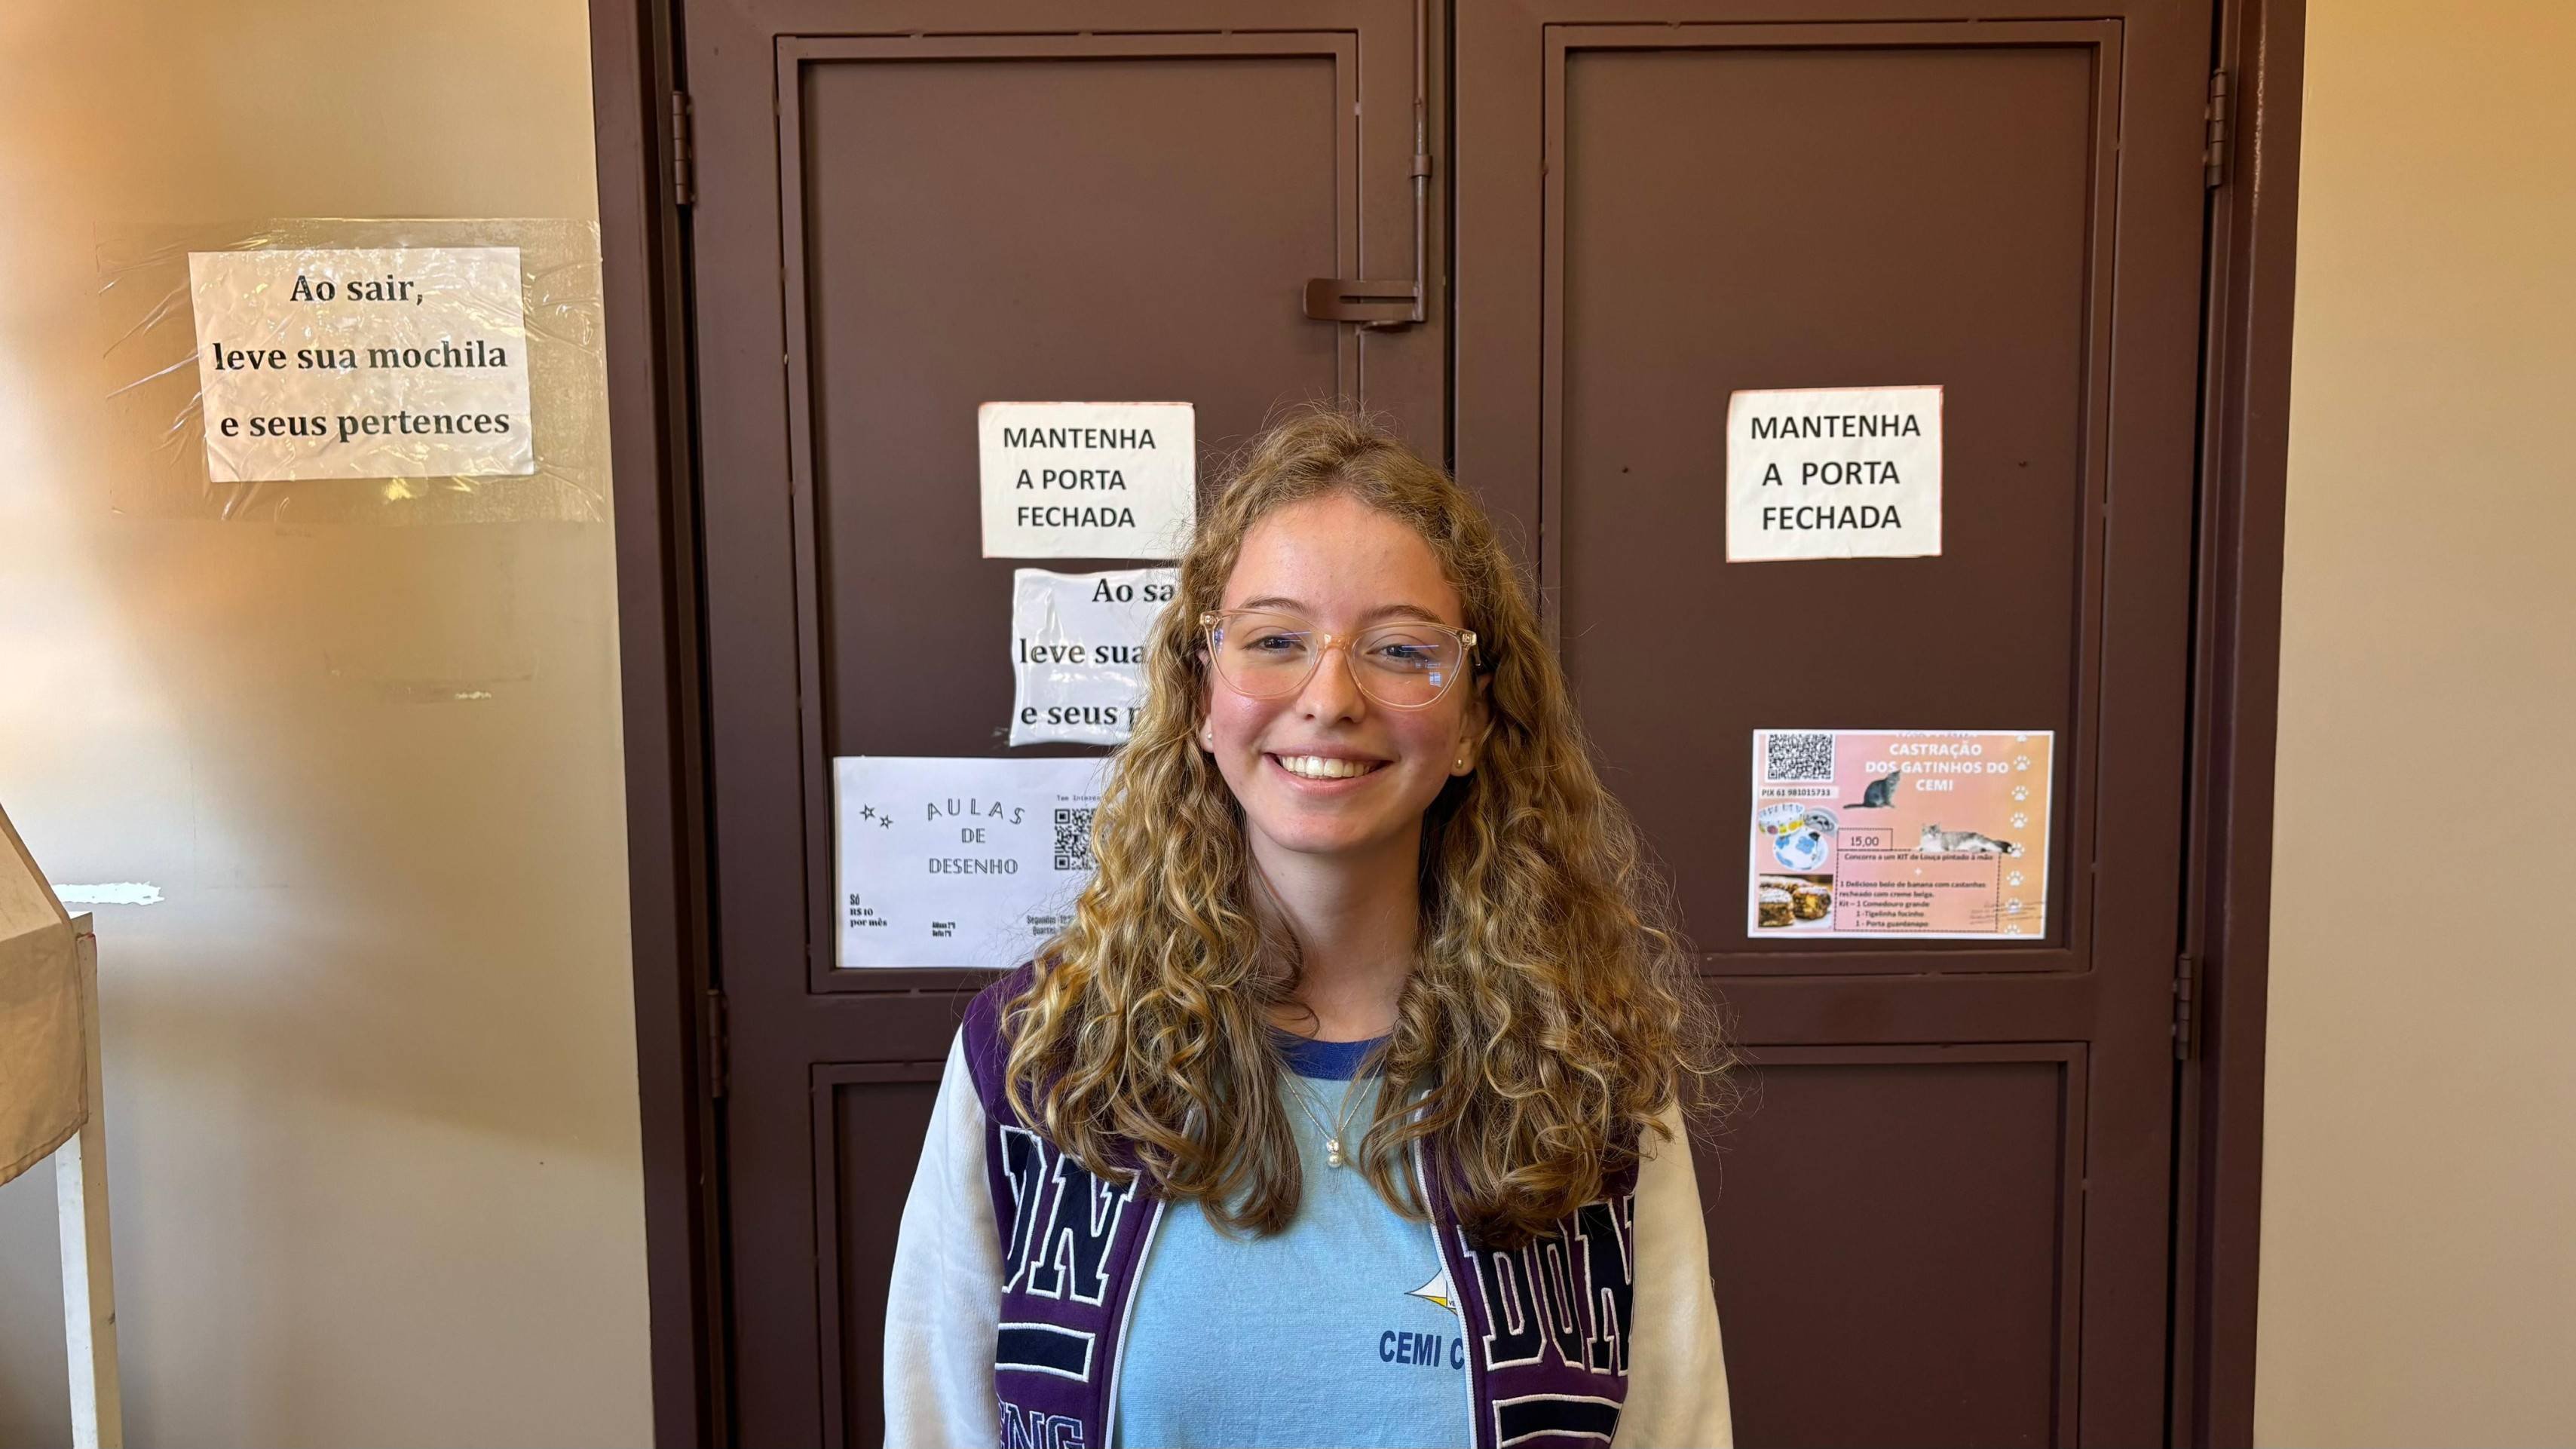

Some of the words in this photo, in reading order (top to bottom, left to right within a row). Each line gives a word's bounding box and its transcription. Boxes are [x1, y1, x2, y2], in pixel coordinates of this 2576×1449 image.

[290, 274, 335, 302] Ao
[347, 274, 424, 306] sair,
[214, 342, 286, 370] leve
[297, 347, 357, 369] sua
[369, 340, 507, 369] mochila
[220, 416, 239, 437] e
[250, 414, 327, 436] seus
[338, 409, 510, 443] pertences
[1751, 414, 1921, 440] MANTENHA
[1003, 427, 1156, 449] MANTENHA
[1016, 469, 1034, 489] A
[1043, 469, 1126, 490] PORTA
[1762, 463, 1783, 486] A
[1803, 461, 1900, 485] PORTA
[1018, 507, 1135, 528] FECHADA
[1763, 505, 1901, 530] FECHADA
[1092, 578, 1133, 603] Ao
[1020, 639, 1086, 663] leve
[1021, 707, 1037, 724] e
[1047, 706, 1117, 725] seus
[1889, 740, 1983, 758] CASTRAÇÃO
[1866, 761, 1897, 774] DOS
[1901, 761, 1982, 774] GATINHOS
[1986, 761, 2009, 774] DO
[1916, 780, 1953, 792] CEMI
[928, 798, 1025, 825] AULAS
[961, 828, 985, 844] DE
[1851, 836, 1879, 847] 15,00
[929, 858, 1018, 875] DESENHO
[1920, 853, 1940, 862] Louça
[1942, 853, 1970, 862] pintado
[850, 893, 859, 905] Só
[1905, 900, 1930, 908] grande
[850, 919, 867, 927] por
[868, 917, 887, 927] mês
[1379, 1329, 1441, 1368] CEMI
